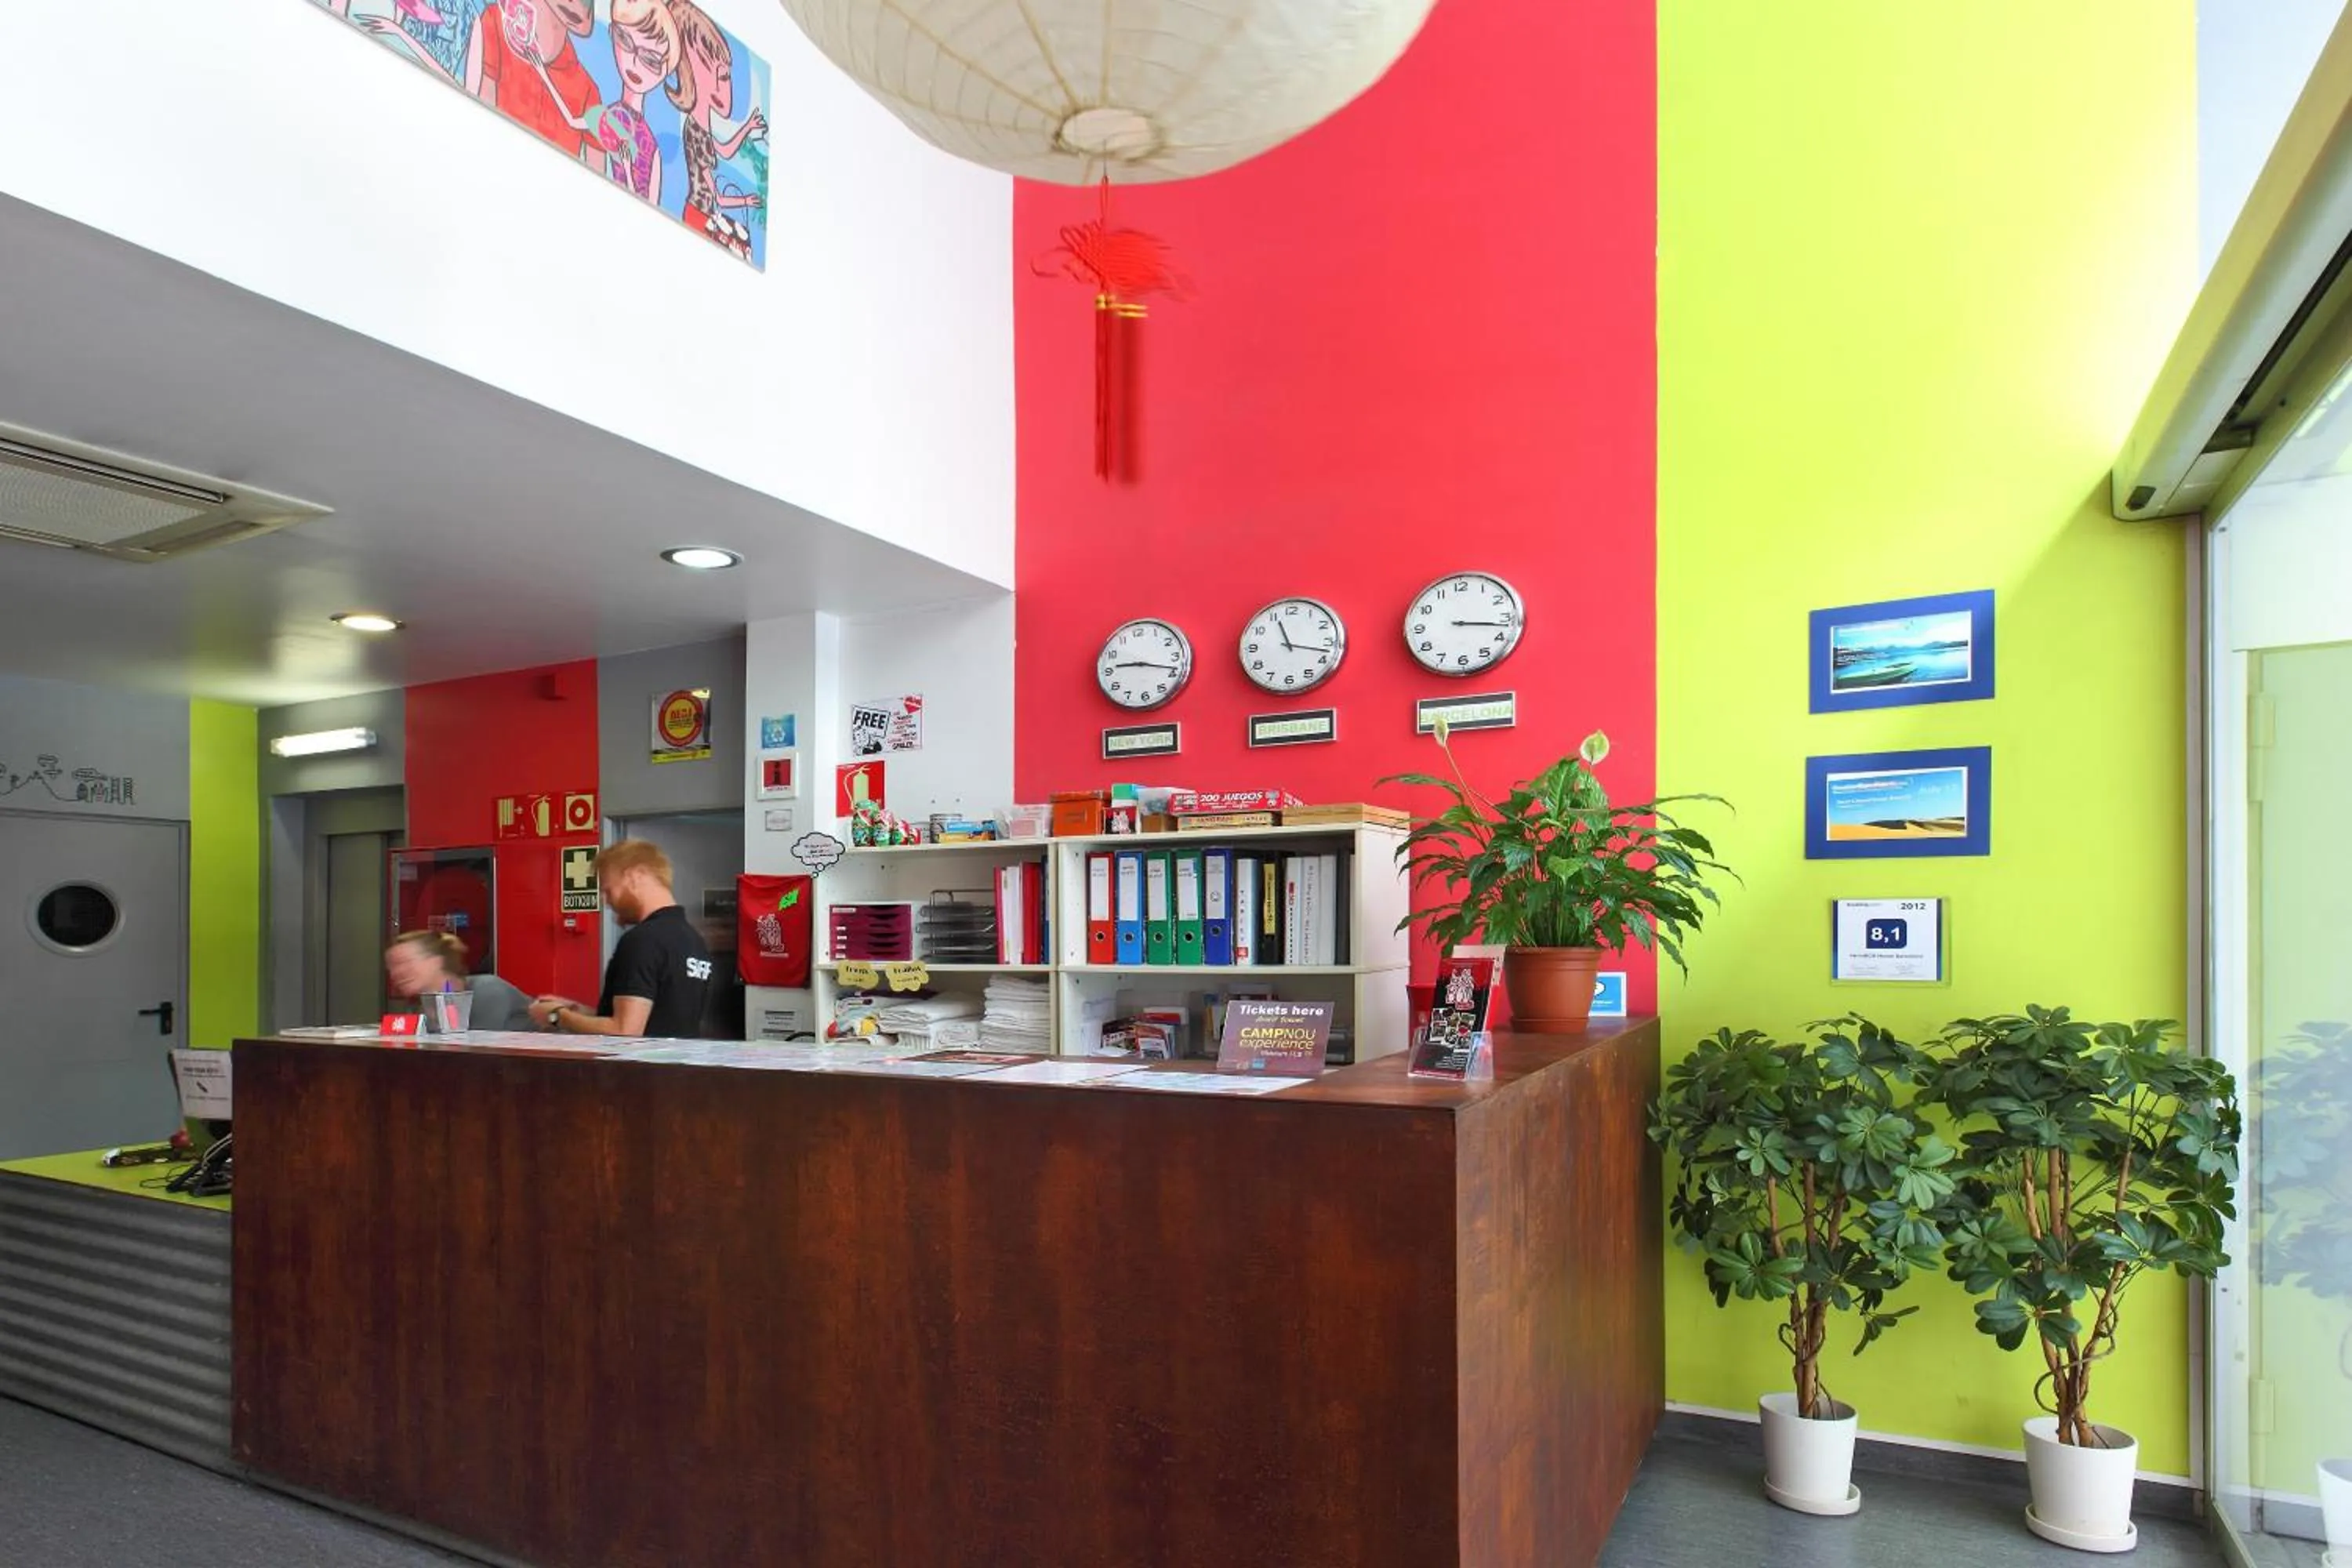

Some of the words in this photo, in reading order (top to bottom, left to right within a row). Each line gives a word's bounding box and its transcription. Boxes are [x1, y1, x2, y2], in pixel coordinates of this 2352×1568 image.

[1454, 582, 1468, 592] 12
[1480, 583, 1485, 593] 1
[1437, 590, 1445, 599] 11
[1493, 595, 1504, 606] 2
[1285, 607, 1298, 615] 12
[1308, 609, 1312, 619] 1
[1421, 605, 1432, 615] 10
[1269, 612, 1277, 622] 11
[1500, 613, 1511, 623] 3
[1254, 626, 1265, 635] 10
[1319, 621, 1328, 630] 2
[1414, 624, 1425, 634] 9
[1132, 629, 1144, 637] 12
[1153, 628, 1158, 637] 1
[1494, 632, 1504, 642] 4
[1119, 637, 1127, 645] 11
[1163, 637, 1172, 647] 2
[1323, 637, 1334, 647] 3
[1248, 644, 1258, 653] 9
[1421, 641, 1432, 652] 8
[1107, 650, 1117, 659] 10
[1171, 652, 1180, 662] 3
[1436, 652, 1446, 662] 7
[1479, 647, 1490, 658] 5
[1318, 655, 1327, 664] 4
[1458, 655, 1469, 666] 6
[1253, 661, 1264, 670] 8
[1105, 667, 1114, 677] 9
[1266, 672, 1275, 681] 7
[1304, 669, 1314, 678] 5
[1284, 675, 1294, 684] 6
[1112, 682, 1120, 691] 8
[1157, 684, 1167, 693] 5
[1123, 691, 1132, 699] 7
[1141, 691, 1150, 701] 6
[1421, 705, 1511, 723] BARCELONA
[853, 710, 886, 729] FREE
[1258, 720, 1327, 735] BRISBANE
[1109, 737, 1135, 748] NEW
[1139, 734, 1173, 745] YORK
[1221, 792, 1263, 802] JUEGOS
[1871, 927, 1900, 943] 8,1
[1240, 1005, 1288, 1016] Tickets
[1291, 1005, 1324, 1016] here
[1241, 1028, 1316, 1040] CAMPNOU
[1240, 1039, 1316, 1051] experience
